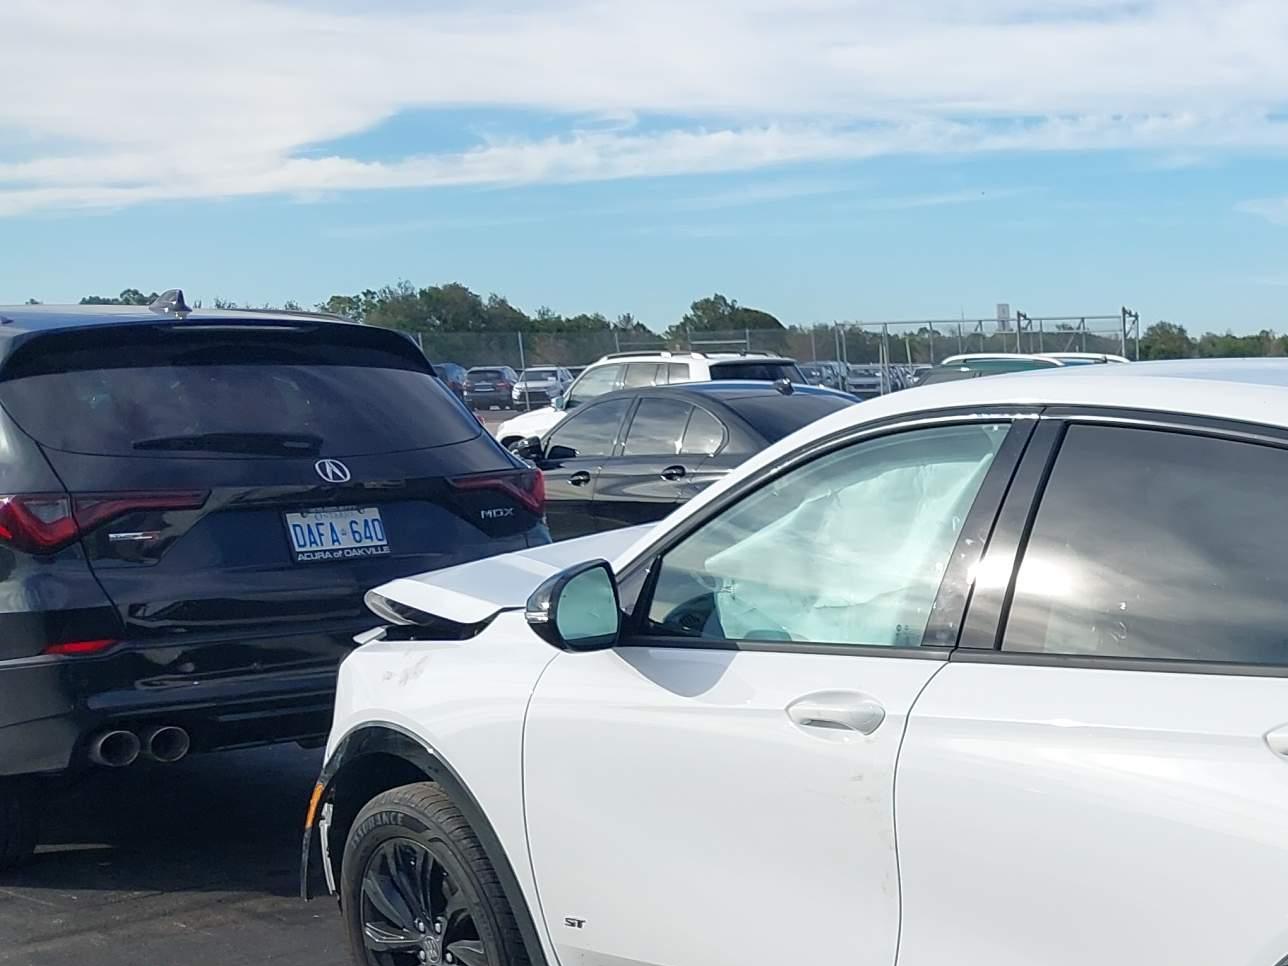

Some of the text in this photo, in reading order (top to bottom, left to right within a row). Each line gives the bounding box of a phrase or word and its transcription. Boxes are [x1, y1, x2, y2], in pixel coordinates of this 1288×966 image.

[481, 508, 514, 519] MDX
[298, 546, 392, 560] ACURA of OAKVILLE
[565, 917, 586, 928] ST
